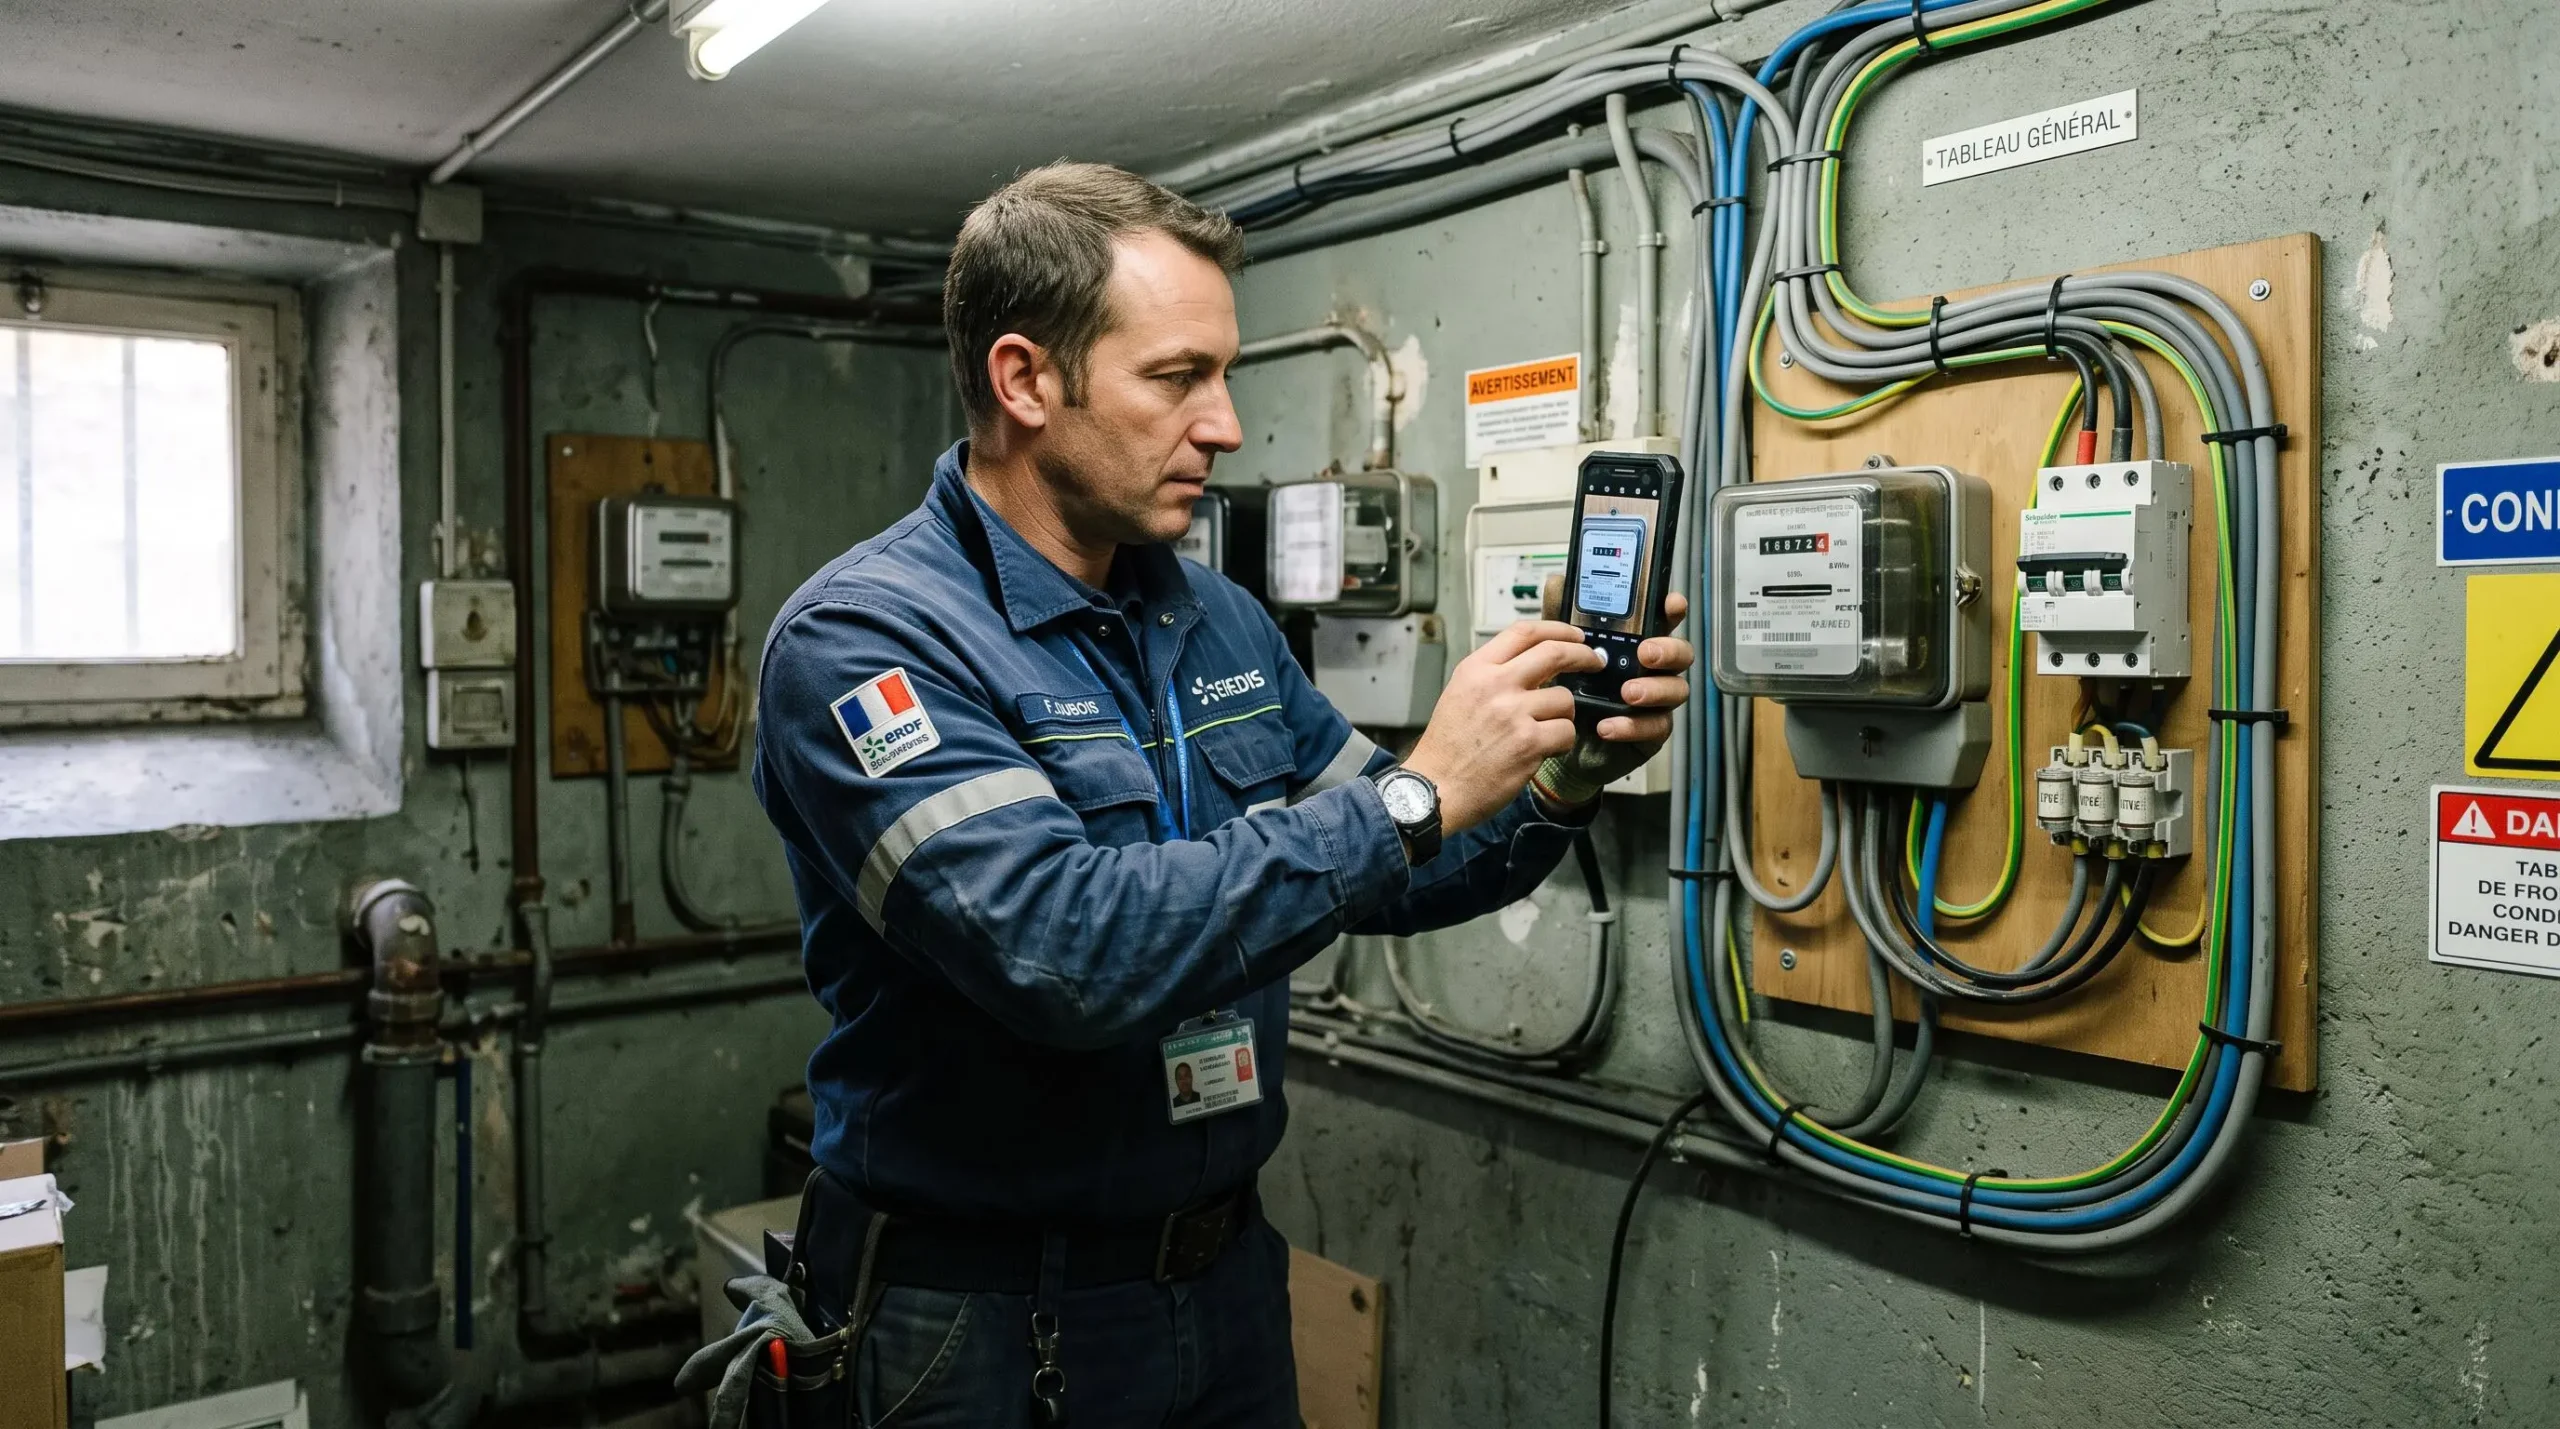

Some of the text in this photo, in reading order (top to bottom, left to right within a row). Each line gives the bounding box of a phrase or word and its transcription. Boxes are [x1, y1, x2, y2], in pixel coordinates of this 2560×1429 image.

[1936, 108, 2121, 169] TABLEAU GÉNÉRAL
[1470, 365, 1575, 397] AVERTISSEMENT
[2461, 489, 2560, 533] CON
[2507, 809, 2560, 838] DA
[2478, 879, 2506, 896] DE
[2493, 903, 2560, 924] COND
[2448, 920, 2539, 945] DANGER
